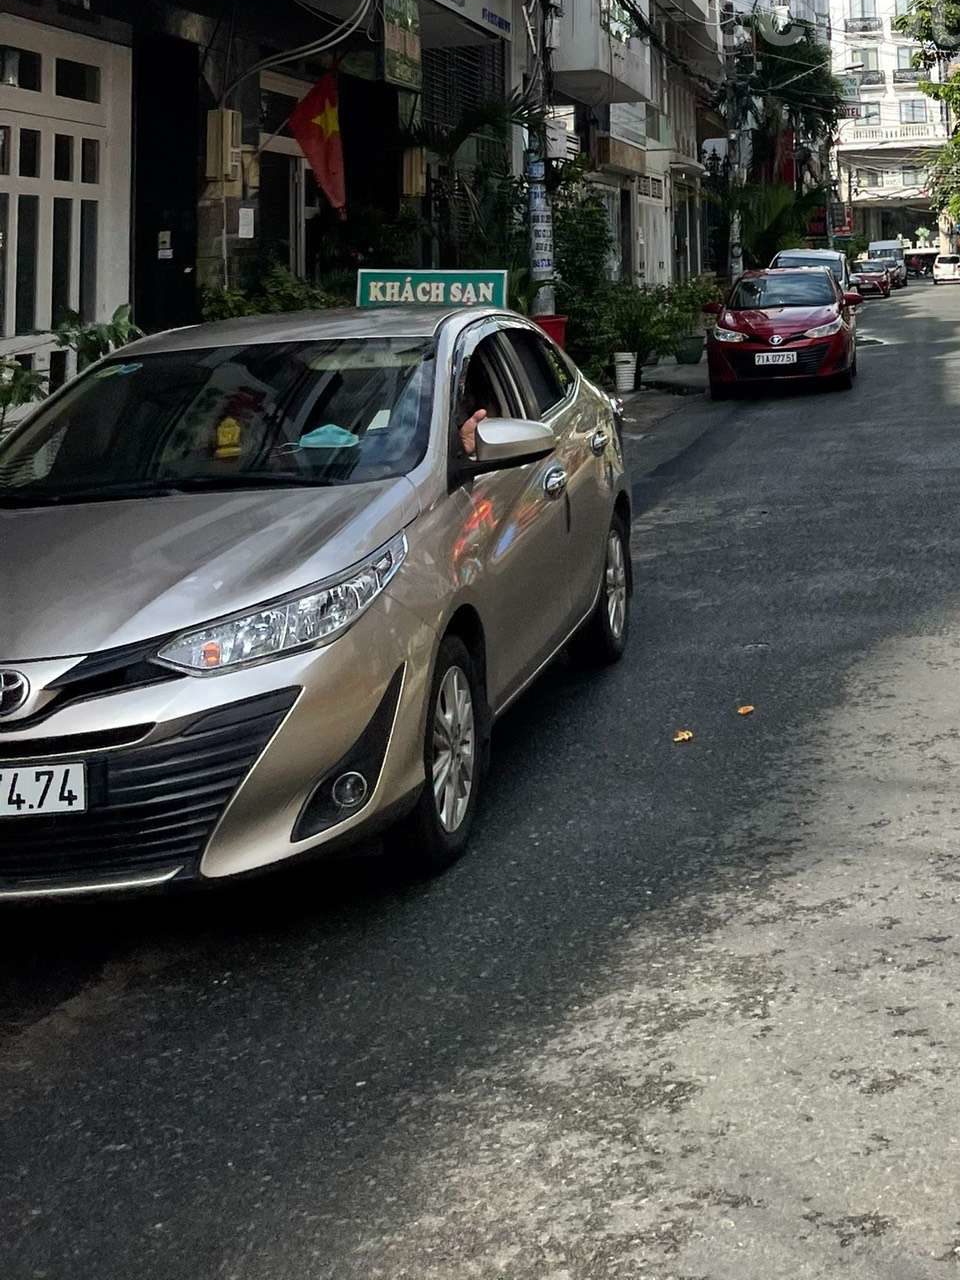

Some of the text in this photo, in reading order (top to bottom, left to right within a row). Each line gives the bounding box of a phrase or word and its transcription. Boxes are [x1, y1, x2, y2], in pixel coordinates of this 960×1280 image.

[368, 276, 495, 306] KHÁCH SẠN
[0, 768, 78, 811] 4.74
